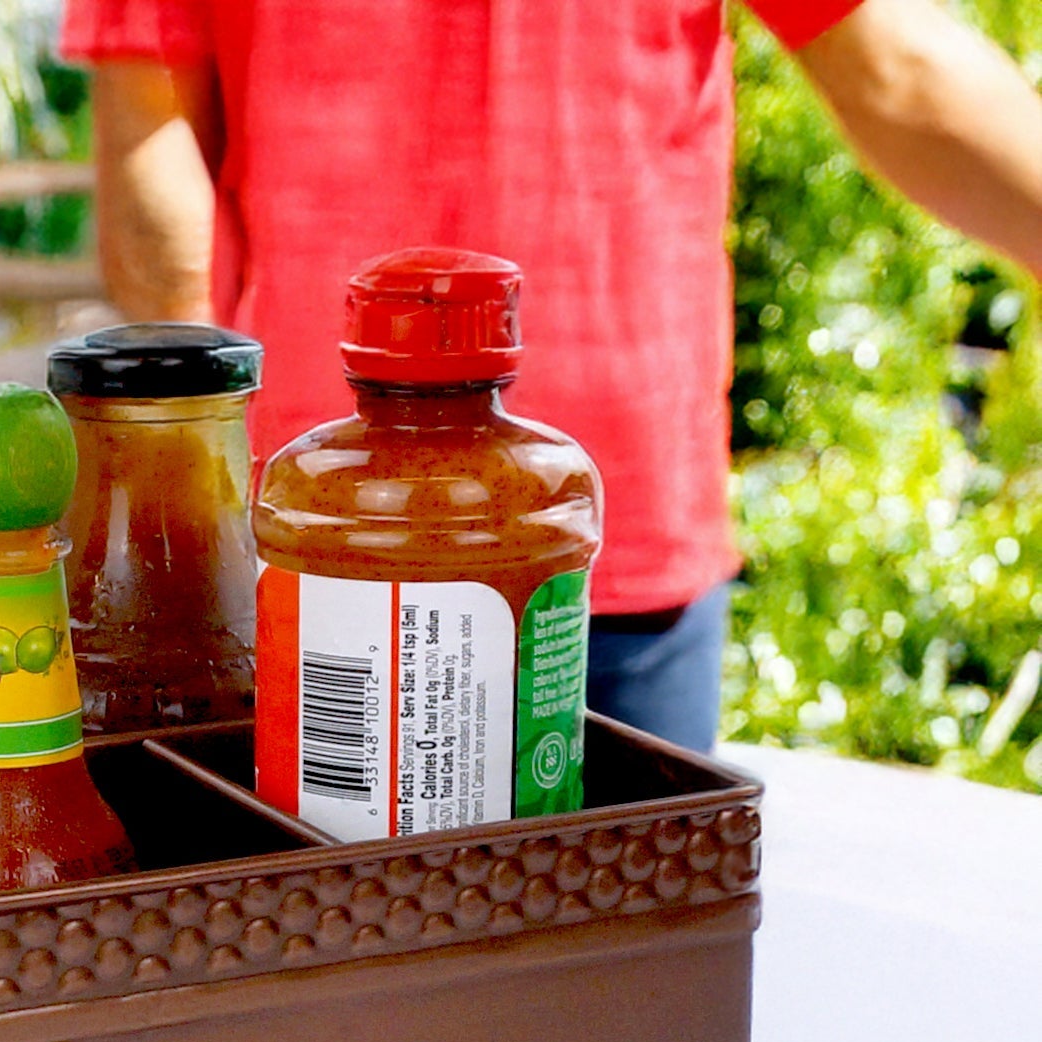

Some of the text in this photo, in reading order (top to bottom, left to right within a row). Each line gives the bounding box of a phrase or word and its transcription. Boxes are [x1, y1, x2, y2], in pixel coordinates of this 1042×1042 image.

[401, 605, 419, 630] (5ml)
[425, 610, 439, 645] Sodium
[460, 614, 472, 638] added
[401, 633, 418, 649] tsp
[401, 652, 416, 666] 1/4
[400, 669, 415, 693] Size:
[425, 680, 440, 692] 0g
[442, 667, 454, 701] Protein
[365, 675, 379, 723] 10012
[400, 696, 415, 718] Serv
[425, 694, 438, 709] Fat
[459, 691, 473, 716] dietary
[425, 712, 437, 735] Total
[400, 735, 416, 771] Servings
[441, 735, 456, 747] 0g
[365, 735, 379, 786] 33148
[441, 749, 453, 774] Carb.
[420, 753, 437, 799] Calories
[440, 776, 452, 799] Total
[397, 773, 414, 805] Facts
[397, 808, 414, 836] ition
